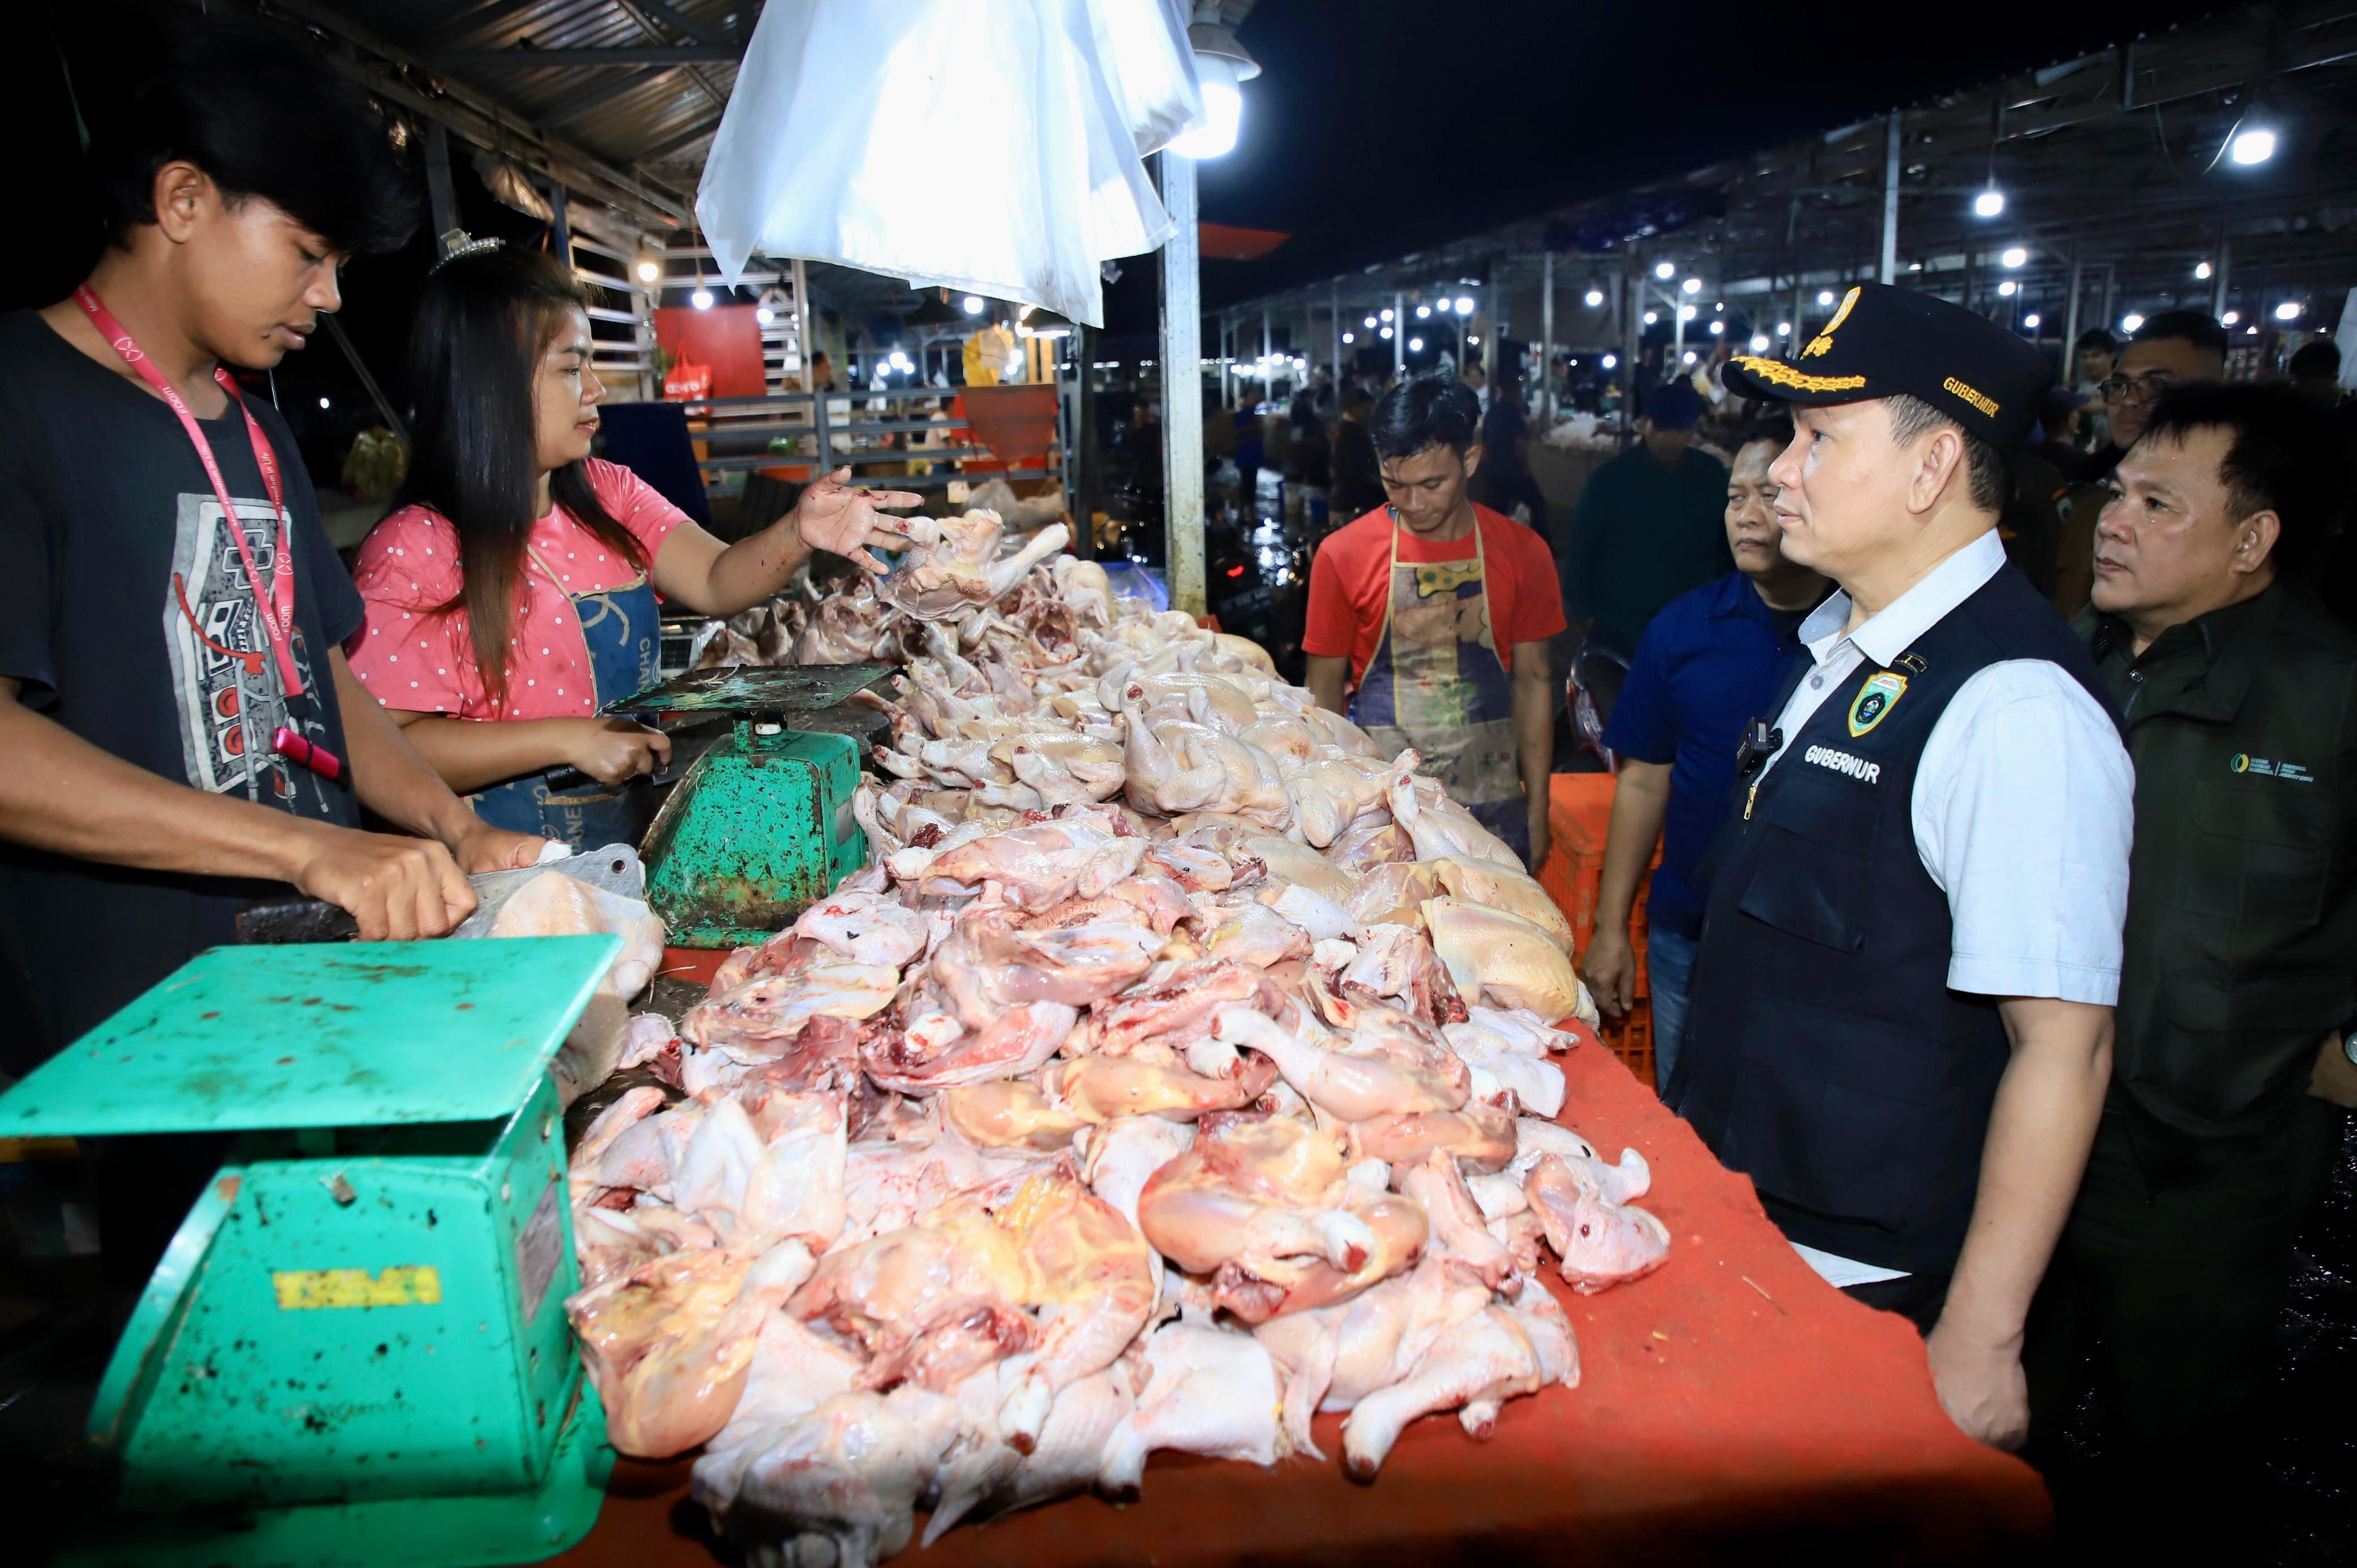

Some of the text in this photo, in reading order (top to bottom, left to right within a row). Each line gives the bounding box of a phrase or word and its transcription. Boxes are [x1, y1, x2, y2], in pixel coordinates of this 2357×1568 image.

[1943, 376, 2000, 418] GUBERNUR
[261, 452, 272, 465] Life
[212, 471, 230, 504] Freedom
[226, 506, 238, 527] More
[266, 613, 282, 641] FOOM
[1805, 744, 1880, 784] GUBERNUR
